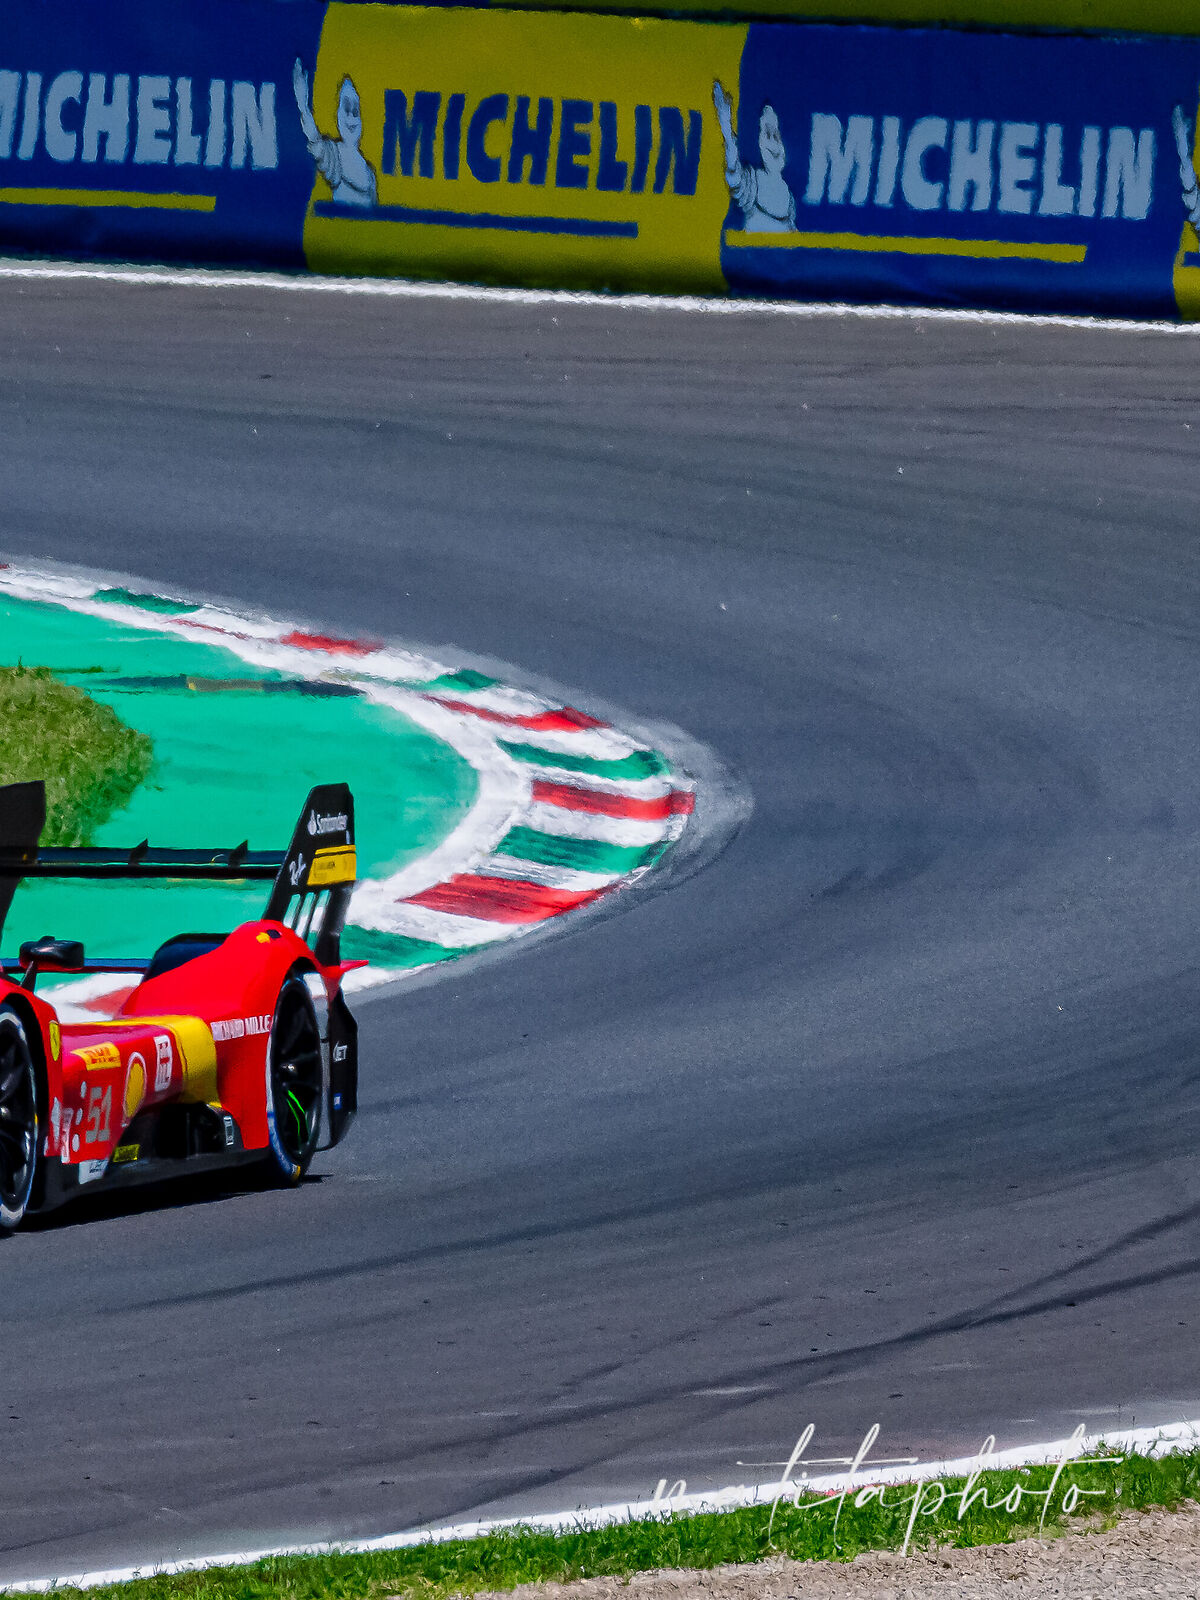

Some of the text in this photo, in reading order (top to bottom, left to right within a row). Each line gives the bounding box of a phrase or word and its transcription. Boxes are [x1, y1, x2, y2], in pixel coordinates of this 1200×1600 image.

[381, 88, 702, 197] MICHELIN
[802, 112, 1154, 220] MICHELIN
[86, 1085, 112, 1143] 51
